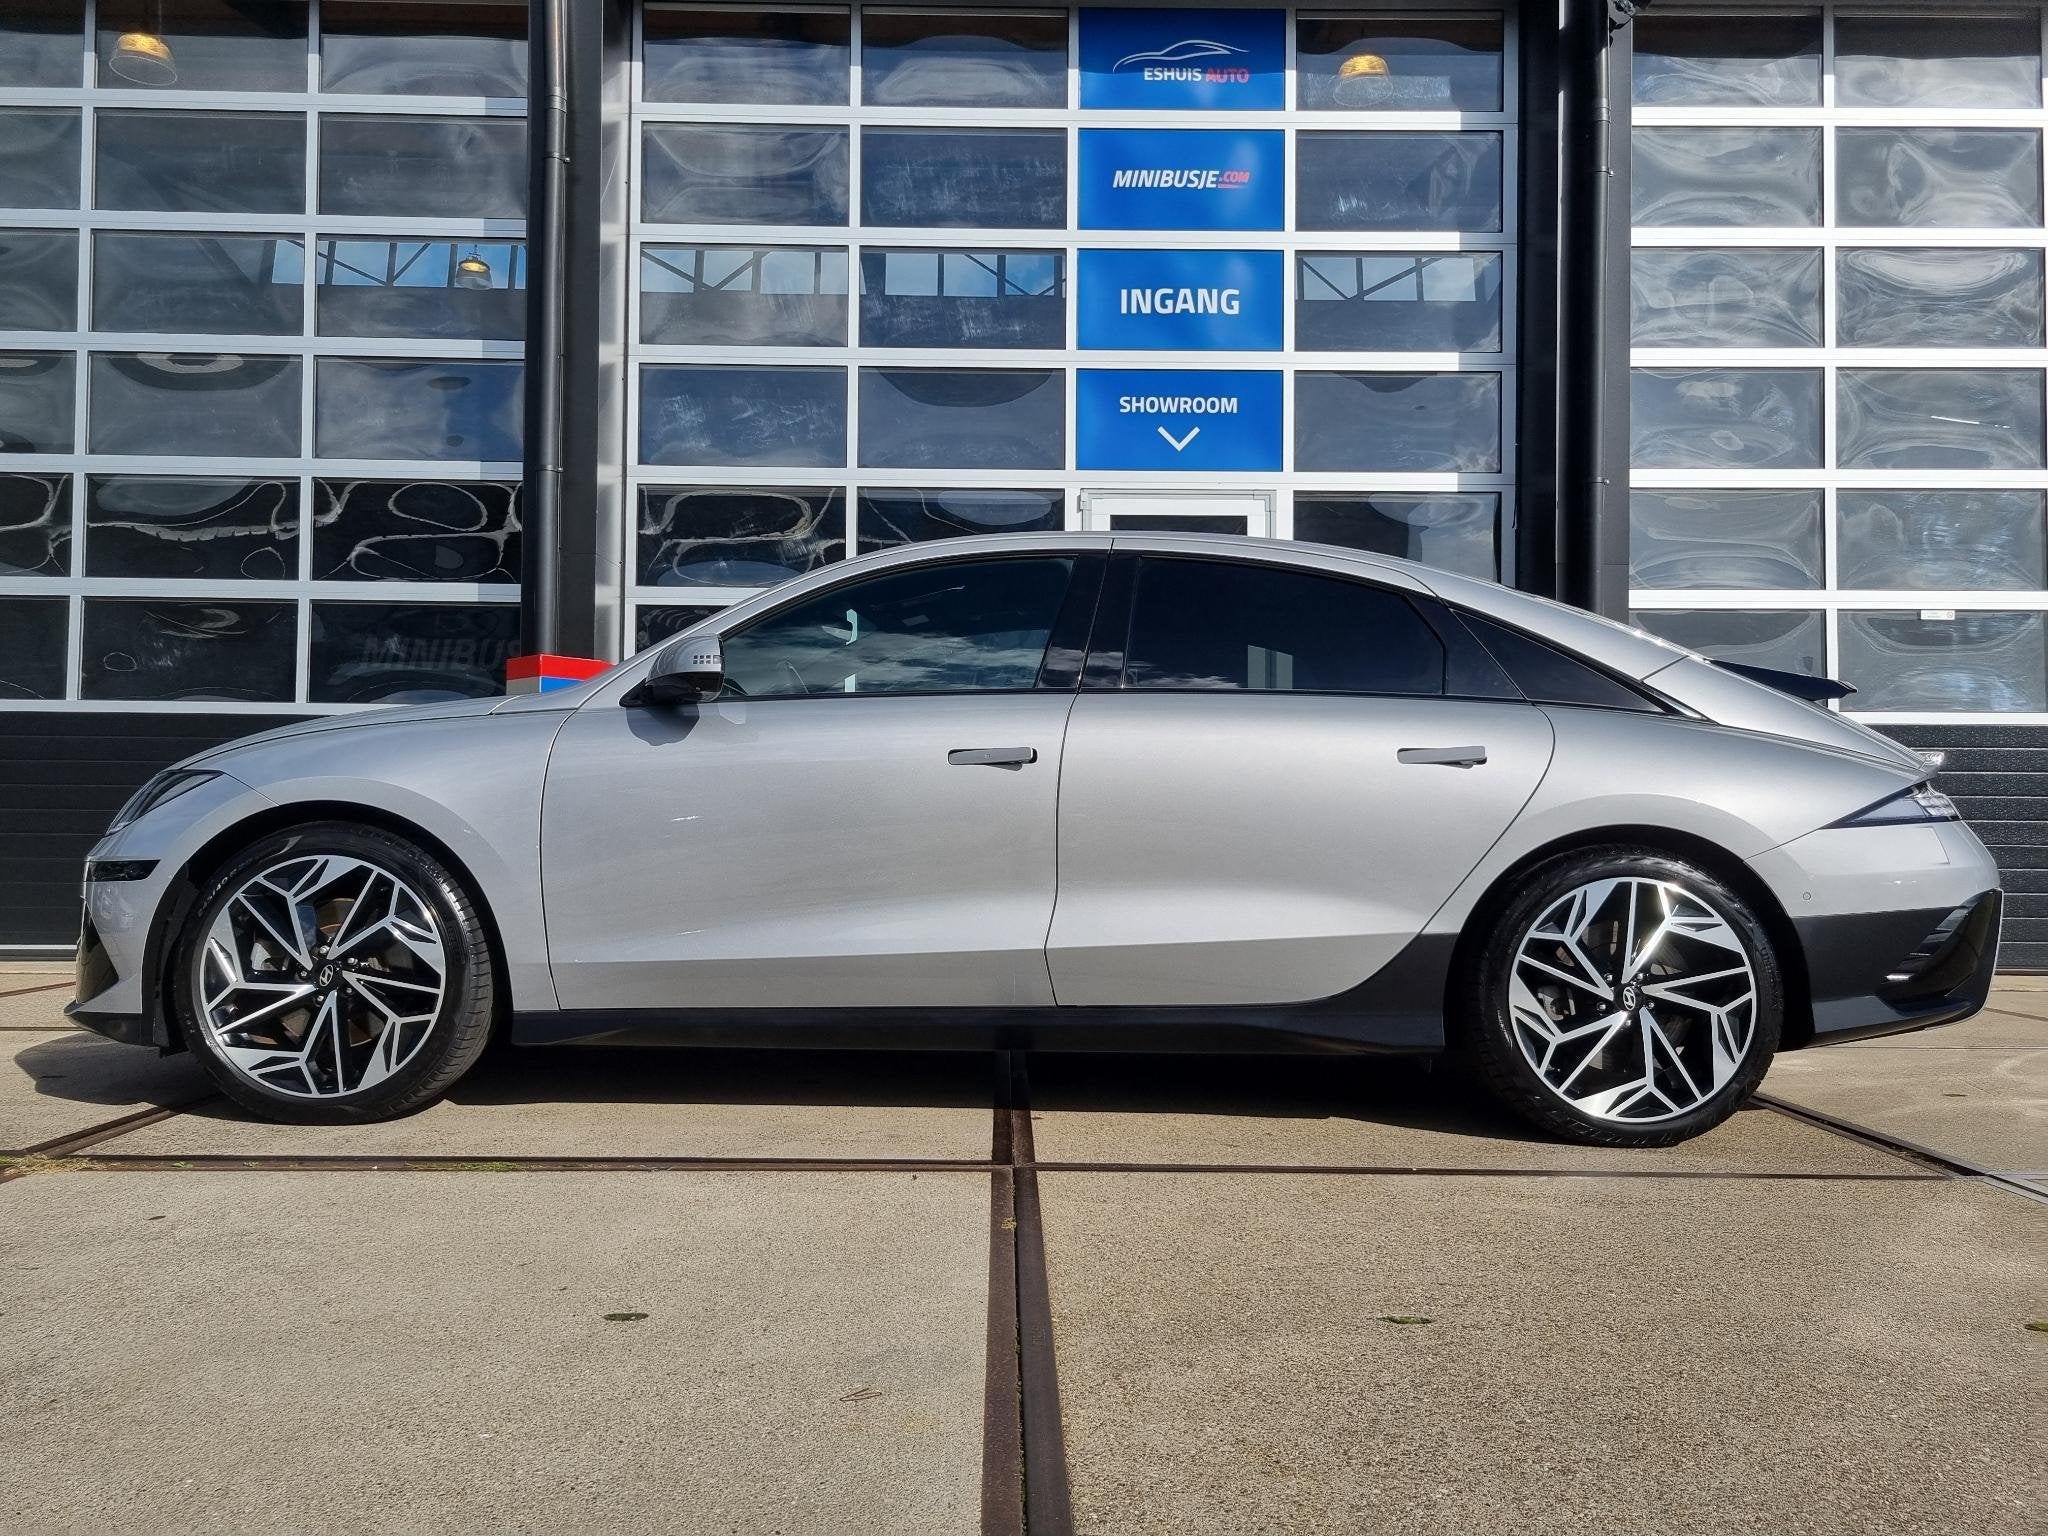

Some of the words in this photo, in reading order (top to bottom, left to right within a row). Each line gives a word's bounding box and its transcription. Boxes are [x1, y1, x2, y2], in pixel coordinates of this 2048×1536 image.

[1143, 67, 1202, 82] ESHUIS
[1204, 67, 1249, 84] AUTO
[1120, 288, 1240, 315] INGANG
[1119, 396, 1238, 414] SHOWROOM
